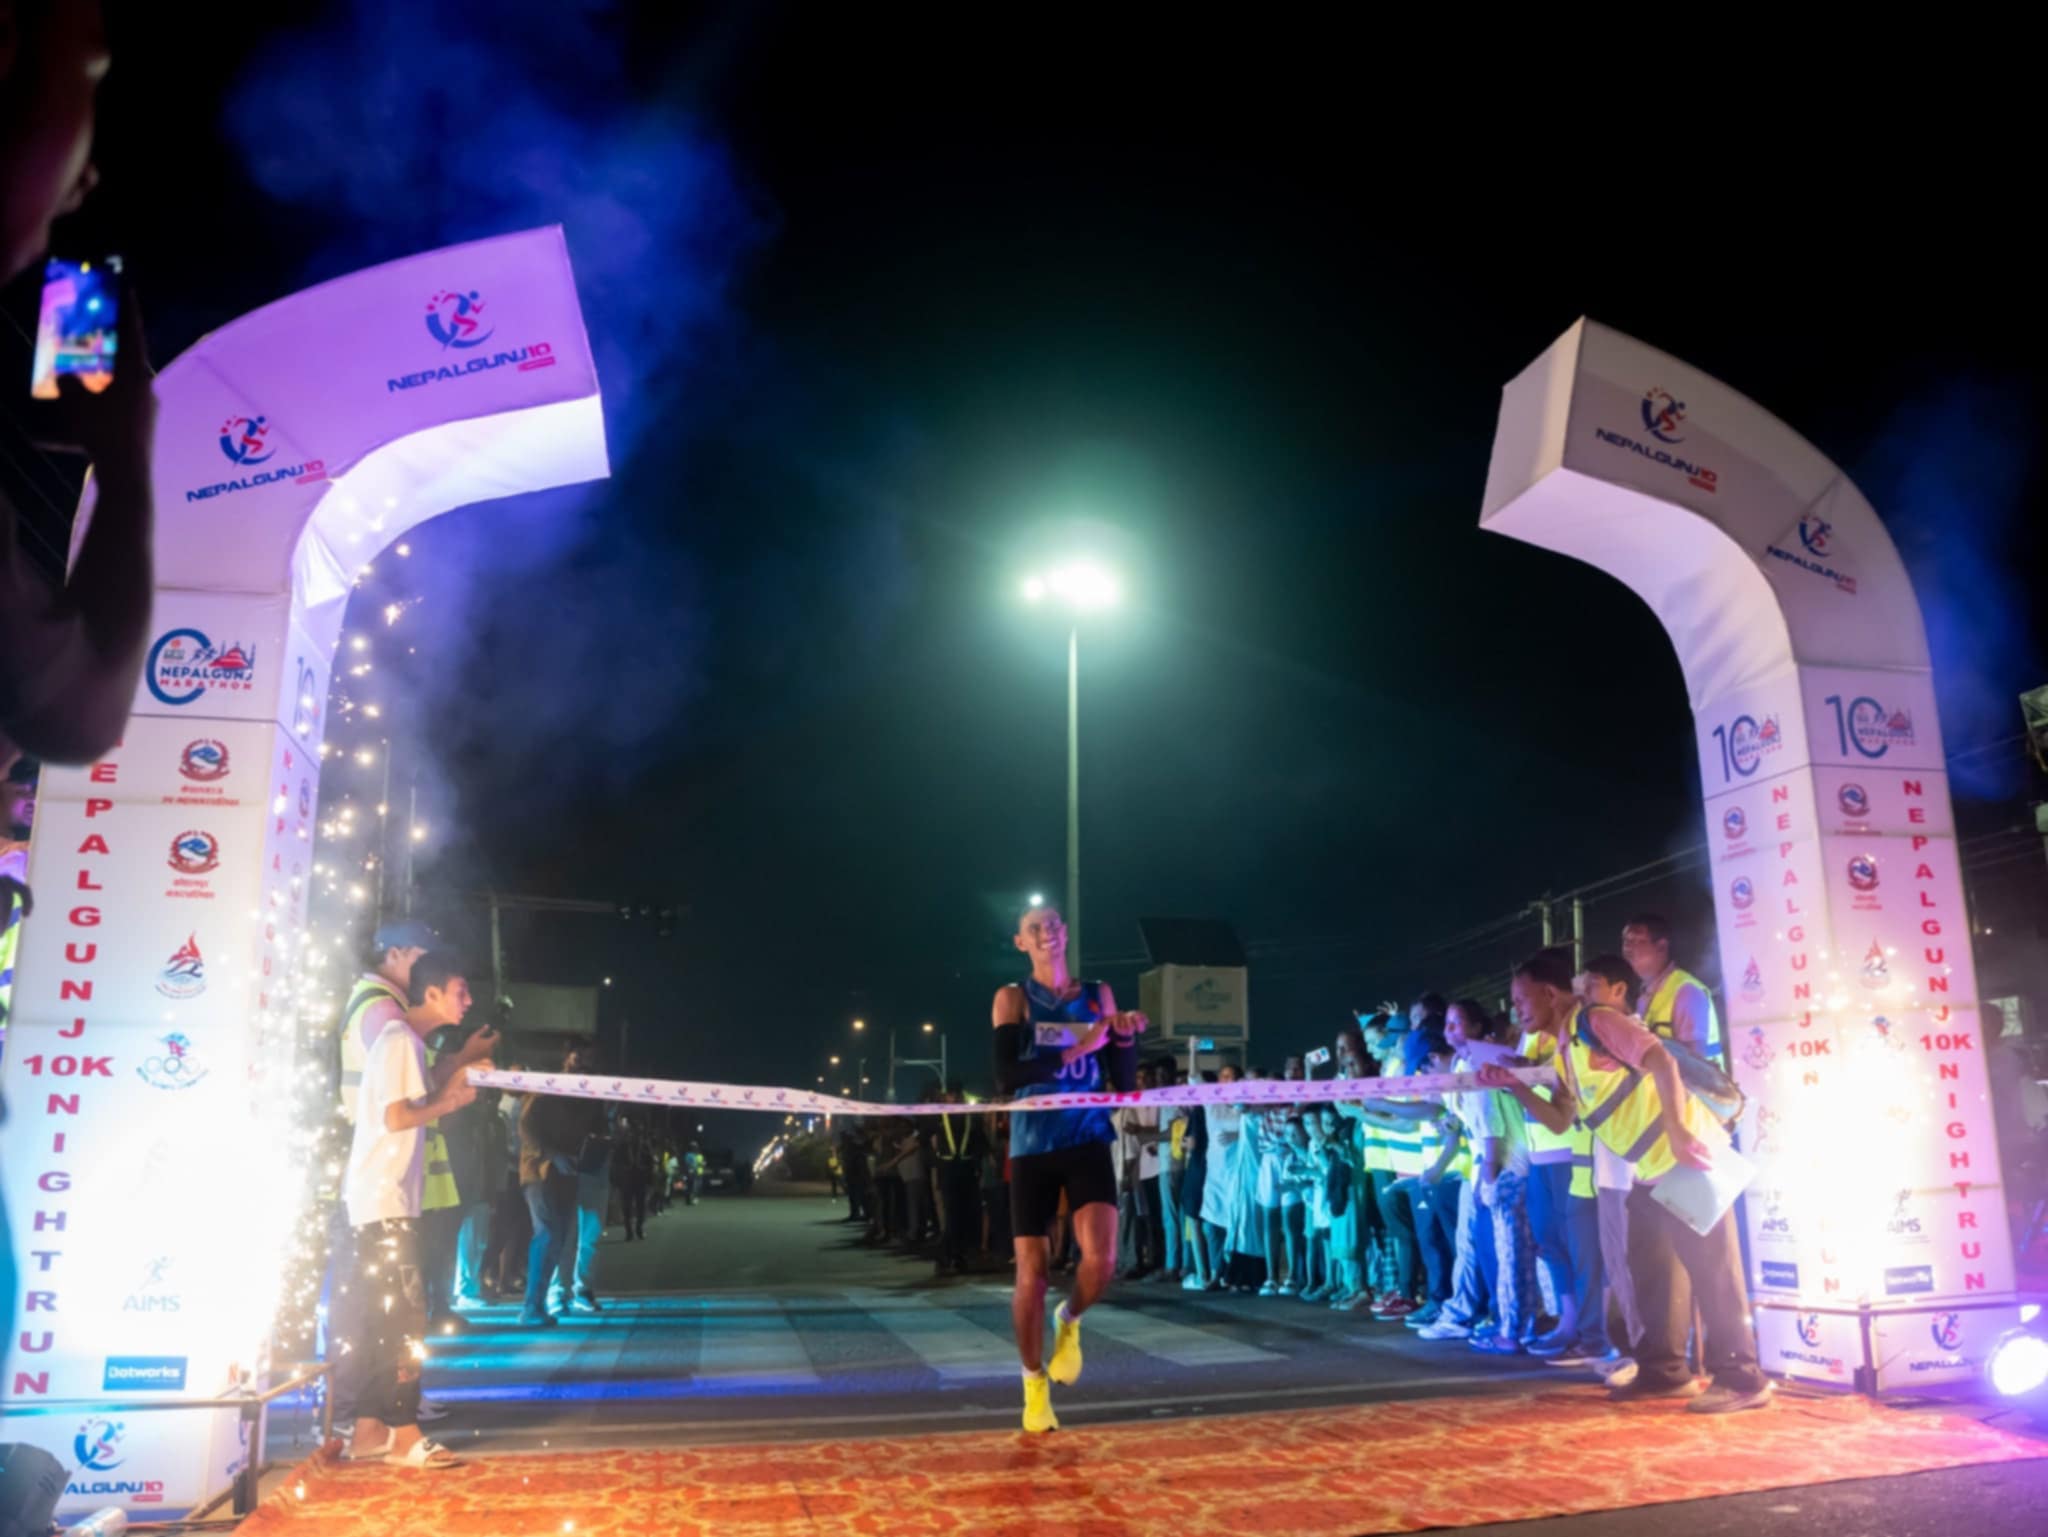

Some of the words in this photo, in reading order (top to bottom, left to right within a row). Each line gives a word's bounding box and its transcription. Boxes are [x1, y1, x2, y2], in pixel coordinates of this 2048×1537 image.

[387, 342, 552, 392] NEPALGUNJ10
[186, 459, 324, 502] NEPALGUNJ10
[160, 666, 253, 681] NEPALGUNJ
[160, 678, 252, 690] MARATHON
[58, 740, 123, 1039] EPALGUNJ
[1772, 784, 1812, 1028] NEPALGUNJ
[1904, 780, 1950, 1022] NEPALGUNJ
[1787, 1038, 1832, 1058] 10K
[1919, 1033, 1973, 1051] 10K
[23, 1054, 115, 1078] 10K
[122, 1294, 181, 1312] AIMS
[65, 1481, 164, 1494] ALGUNJ10
